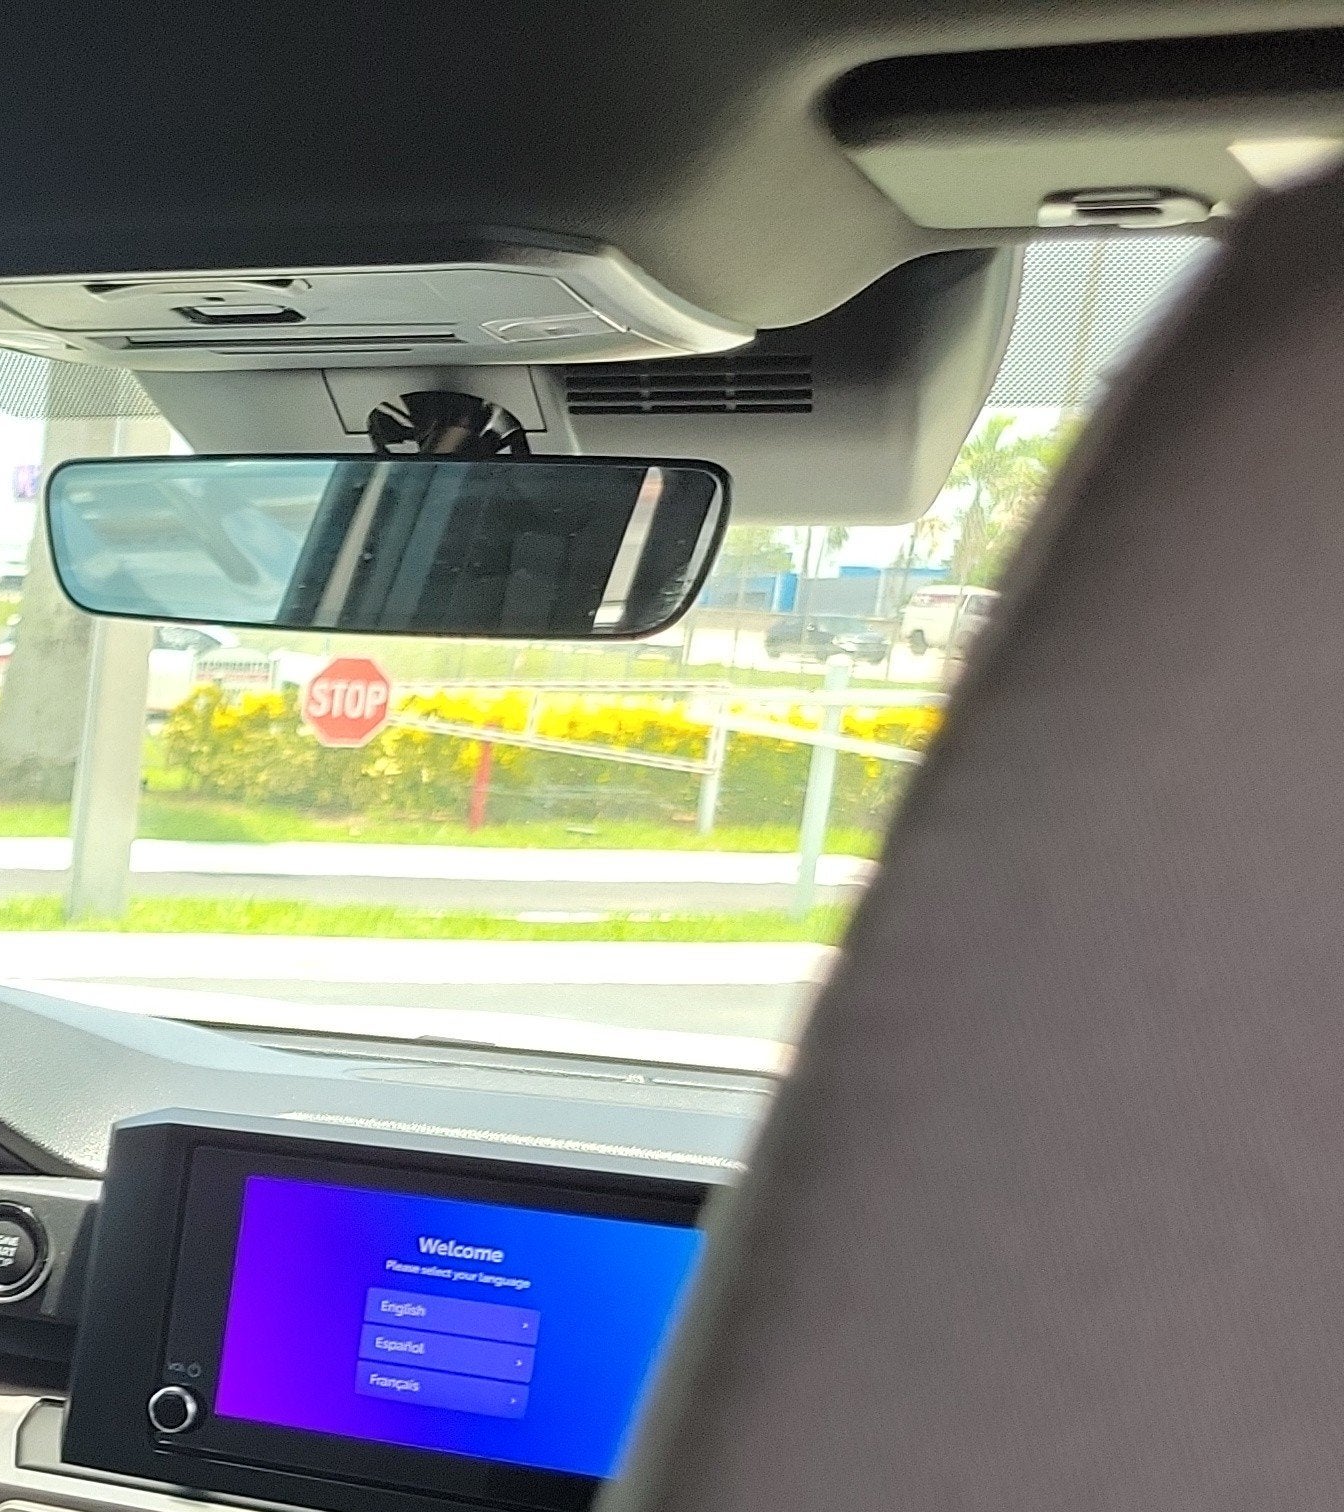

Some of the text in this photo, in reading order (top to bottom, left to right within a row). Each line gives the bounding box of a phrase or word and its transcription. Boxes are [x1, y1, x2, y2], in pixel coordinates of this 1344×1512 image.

[310, 680, 388, 719] STOP
[419, 1236, 505, 1263] Welcome
[385, 1259, 532, 1290] Please select your language
[380, 1300, 427, 1318] English
[375, 1336, 425, 1355] Español
[369, 1373, 420, 1392] Français
